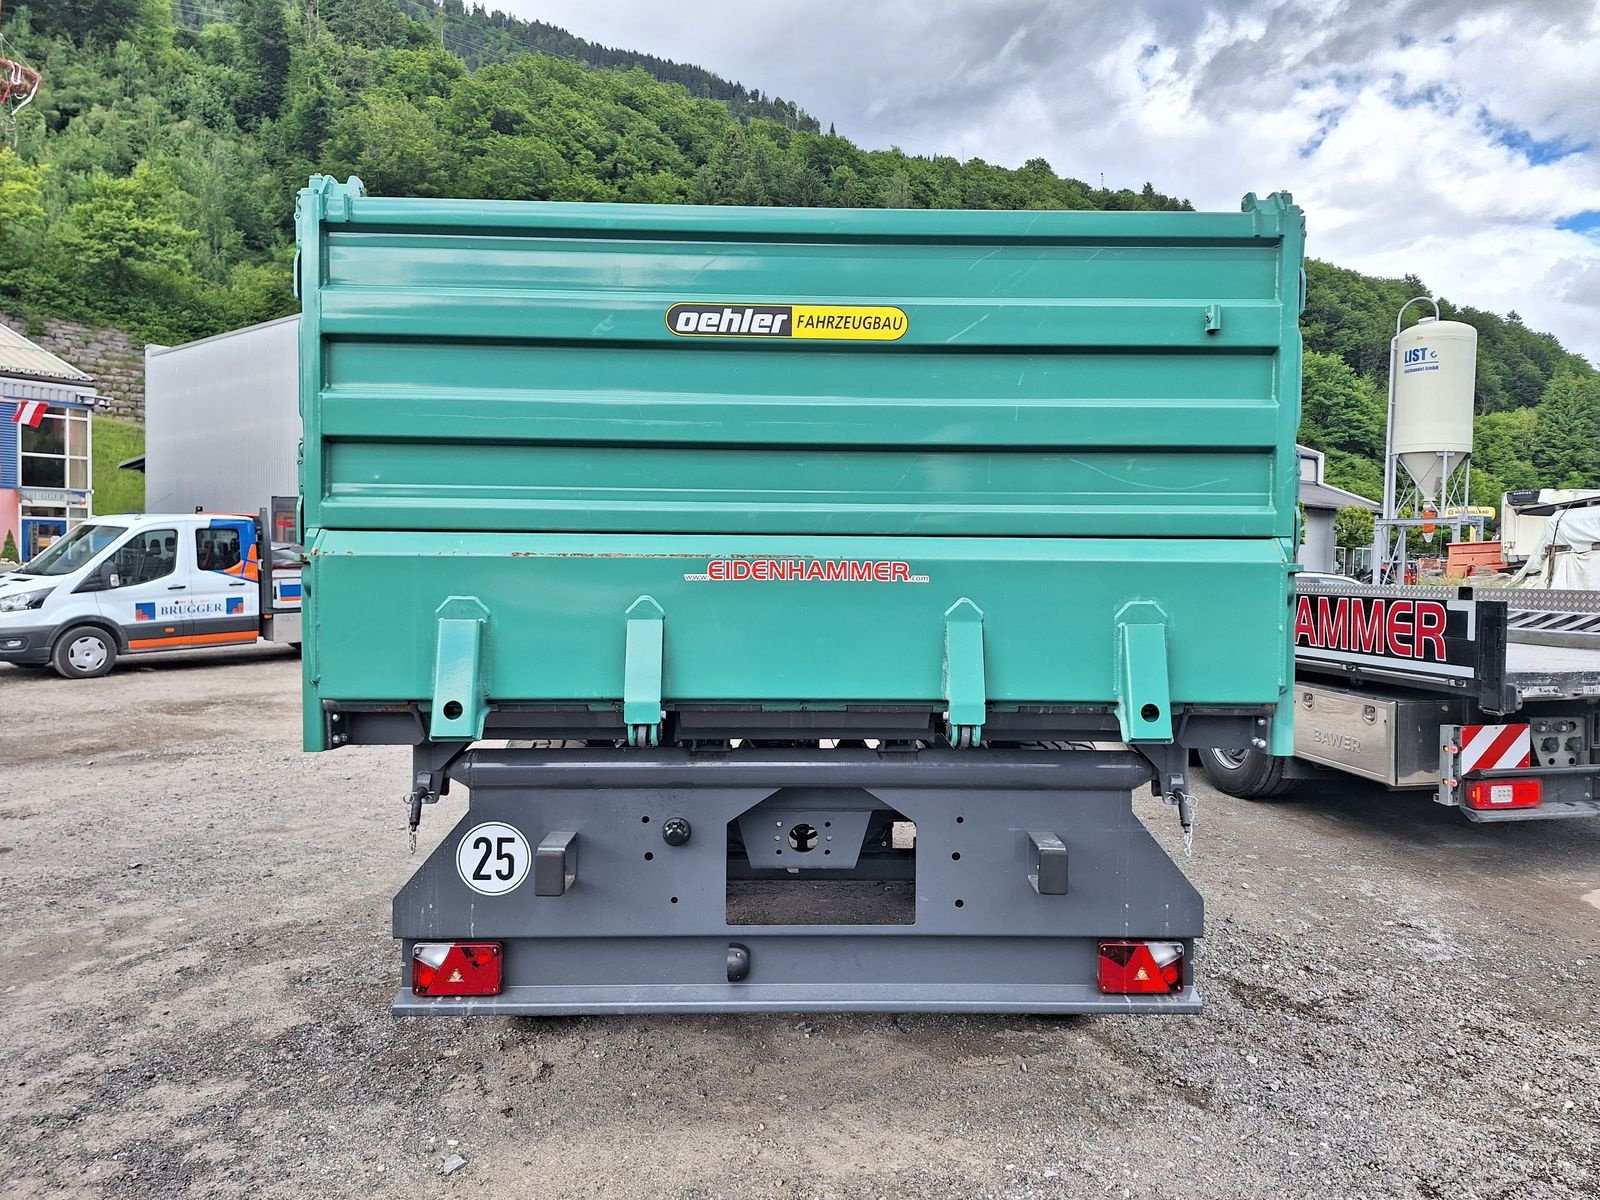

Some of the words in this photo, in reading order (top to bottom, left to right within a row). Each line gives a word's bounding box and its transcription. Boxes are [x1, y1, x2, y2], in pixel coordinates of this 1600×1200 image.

[675, 308, 788, 334] oehler
[797, 314, 904, 331] FAHRZEUGBAU
[1404, 347, 1428, 364] LIST
[684, 560, 929, 582] www.EIDENHAMMER.com
[161, 602, 222, 616] BRUGGER
[1313, 728, 1361, 754] BAWER
[472, 836, 515, 881] 25
